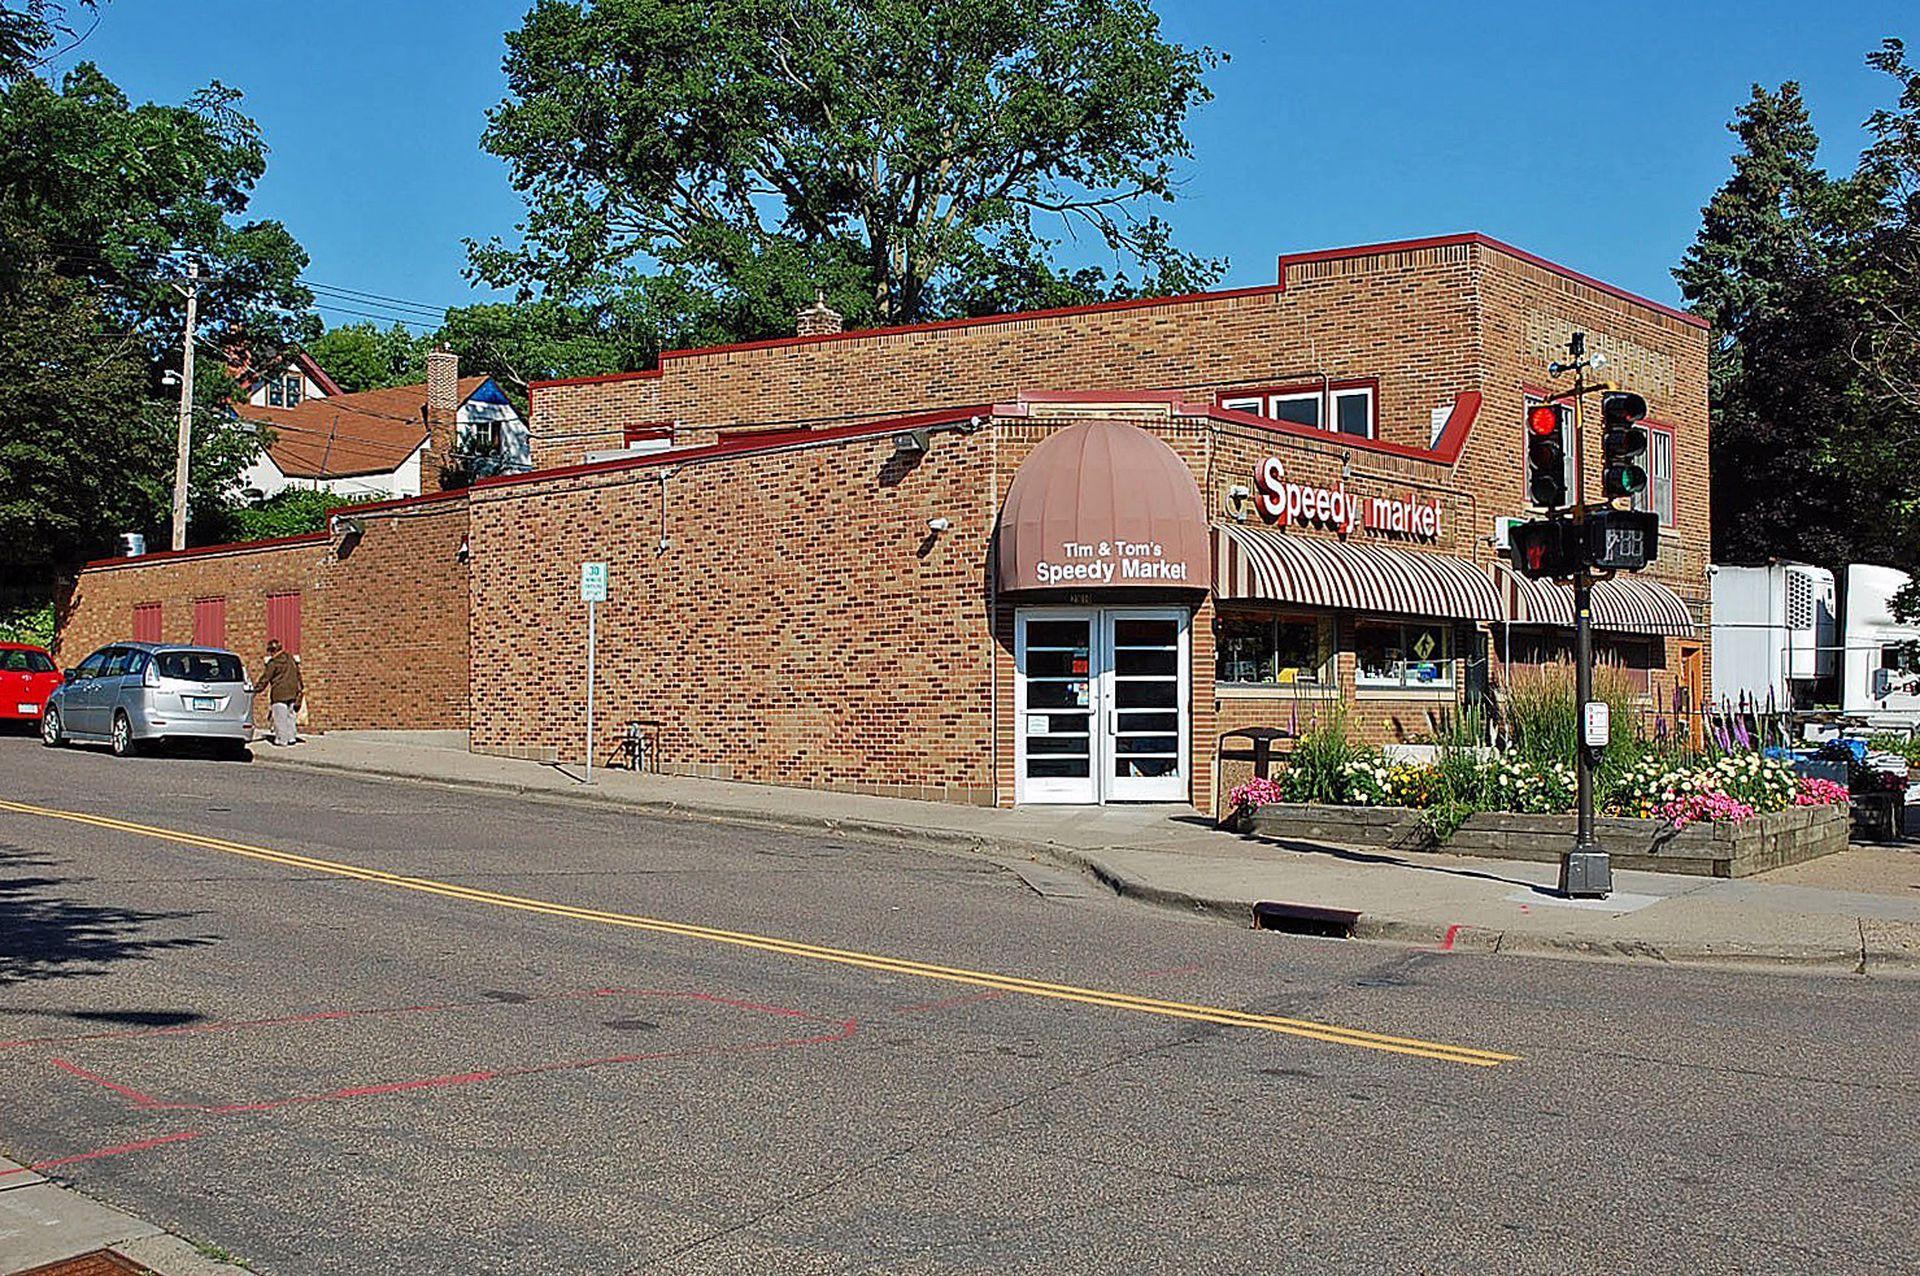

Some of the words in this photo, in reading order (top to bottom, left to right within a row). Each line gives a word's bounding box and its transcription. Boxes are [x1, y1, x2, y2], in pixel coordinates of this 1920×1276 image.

[1258, 457, 1358, 534] Speedy
[1370, 493, 1442, 537] market
[1063, 542, 1093, 557] Tim
[1098, 541, 1110, 556] &
[1115, 541, 1162, 557] Tom's
[1036, 559, 1115, 585] Speedy
[1122, 558, 1187, 580] Market
